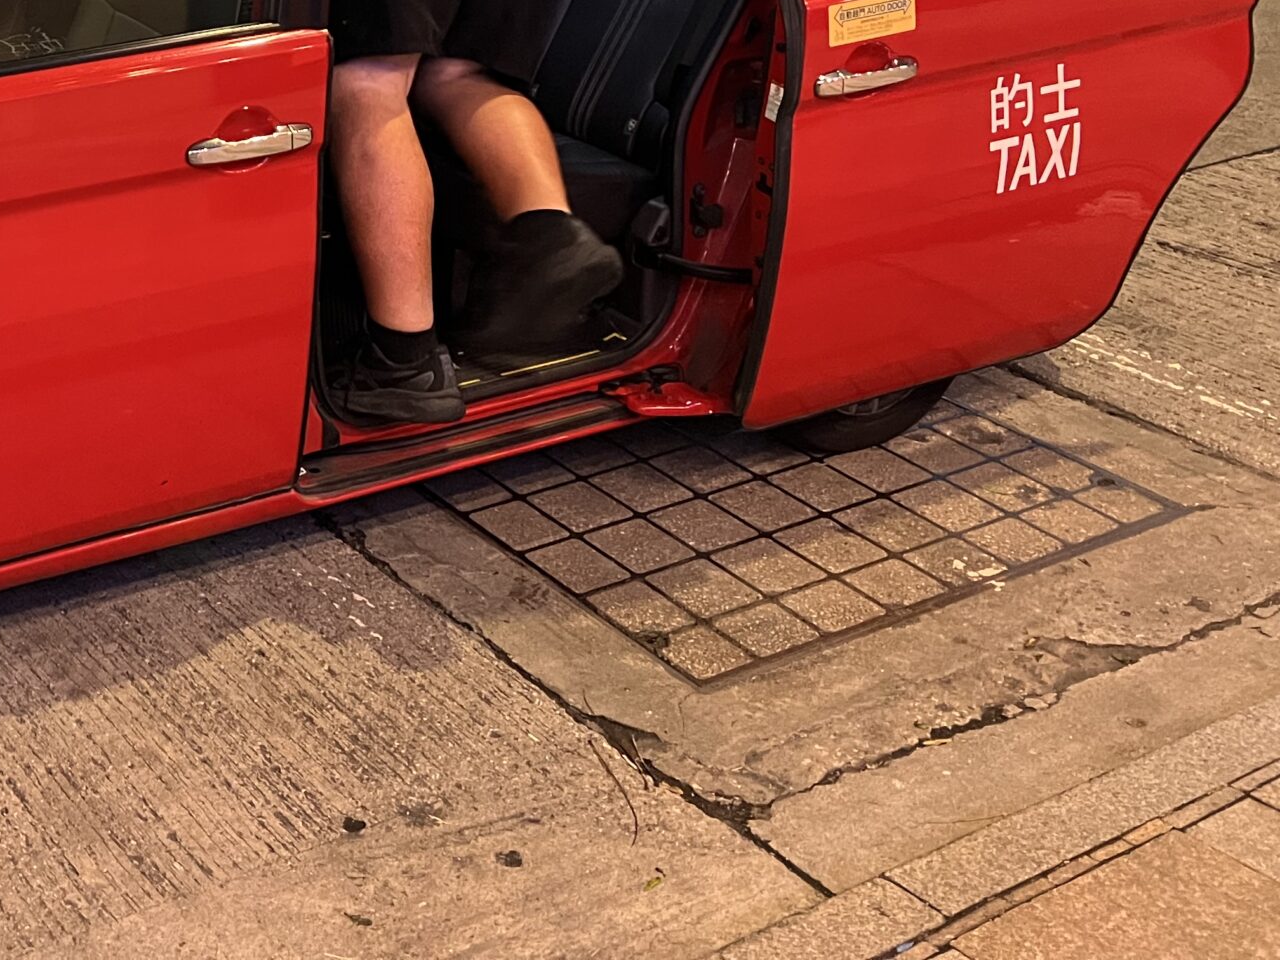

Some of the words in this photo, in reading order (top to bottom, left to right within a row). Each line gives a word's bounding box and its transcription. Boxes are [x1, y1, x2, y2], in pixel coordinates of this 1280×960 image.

[866, 3, 886, 17] AUTO
[990, 63, 1081, 134] 的士
[989, 122, 1082, 194] TAXI
